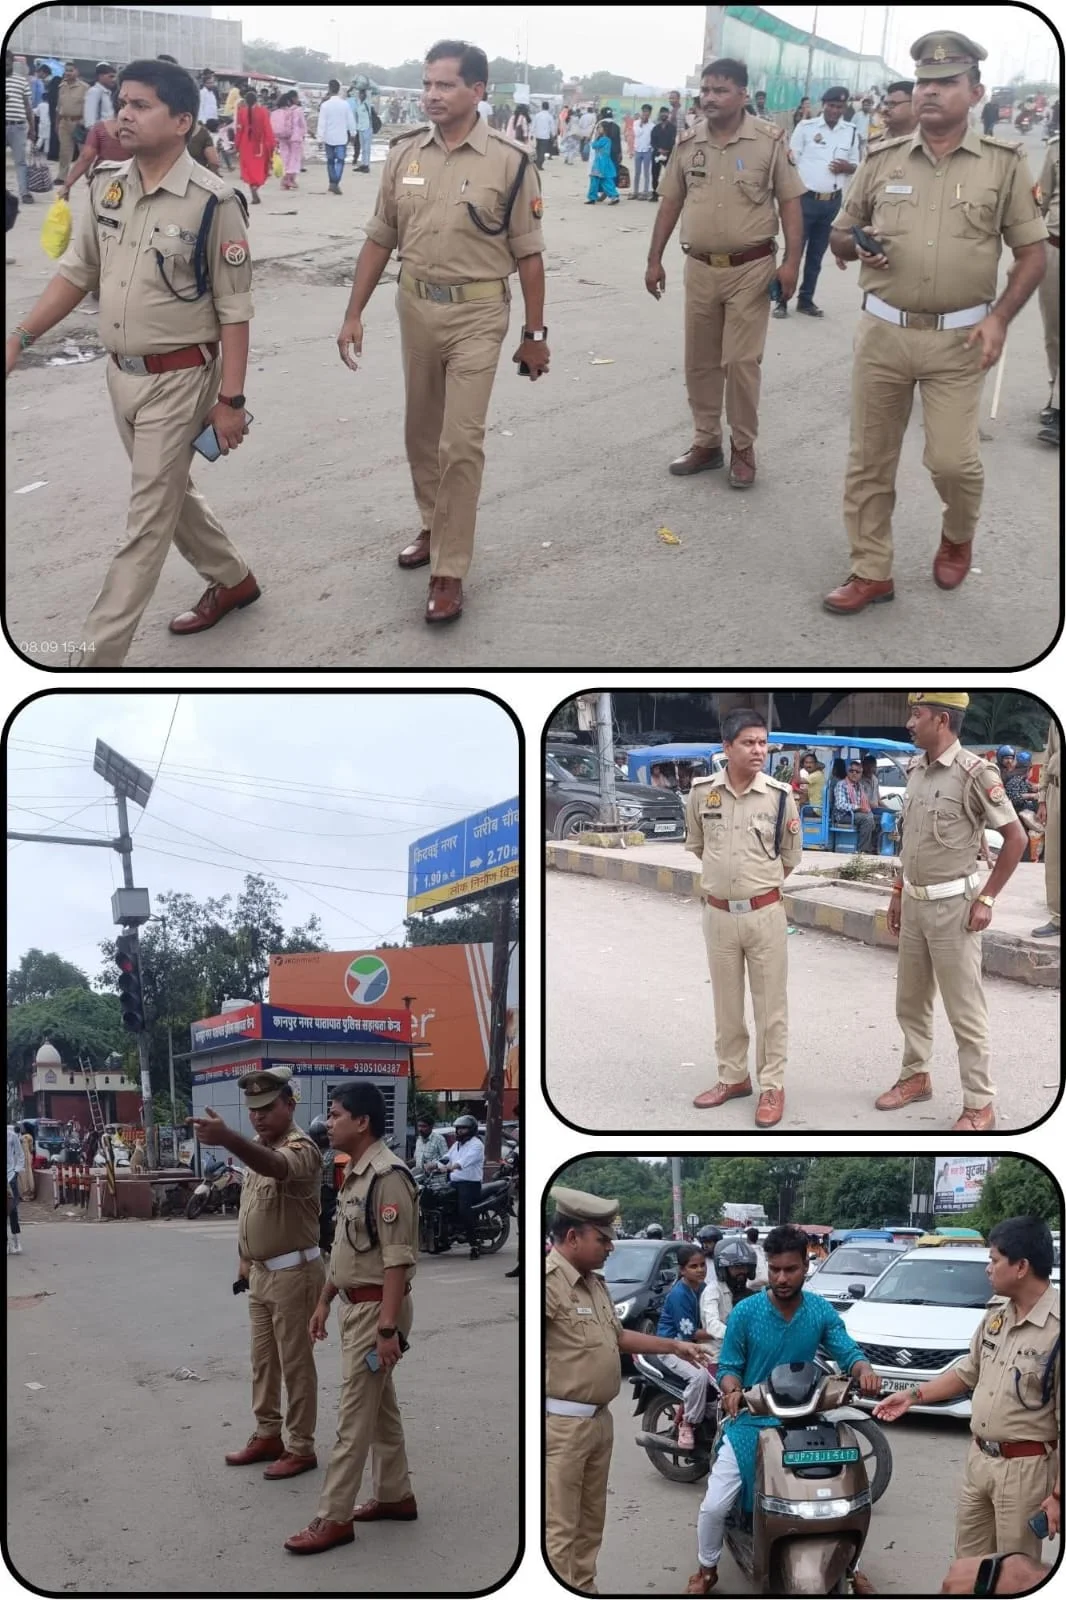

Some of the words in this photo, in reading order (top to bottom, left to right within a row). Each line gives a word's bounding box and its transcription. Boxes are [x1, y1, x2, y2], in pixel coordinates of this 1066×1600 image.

[473, 817, 498, 838] जरीब
[414, 842, 438, 863] किदवई
[441, 835, 458, 851] नगर
[487, 845, 510, 866] 2.70
[423, 870, 442, 889] 1.90
[450, 883, 466, 895] लोक
[471, 873, 497, 889] निर्माण
[272, 1016, 298, 1031] कानपुर
[298, 1017, 313, 1029] नगर
[342, 1015, 360, 1033] पुलिस
[362, 1019, 386, 1032] सहायता
[354, 1062, 401, 1073] 9305104387
